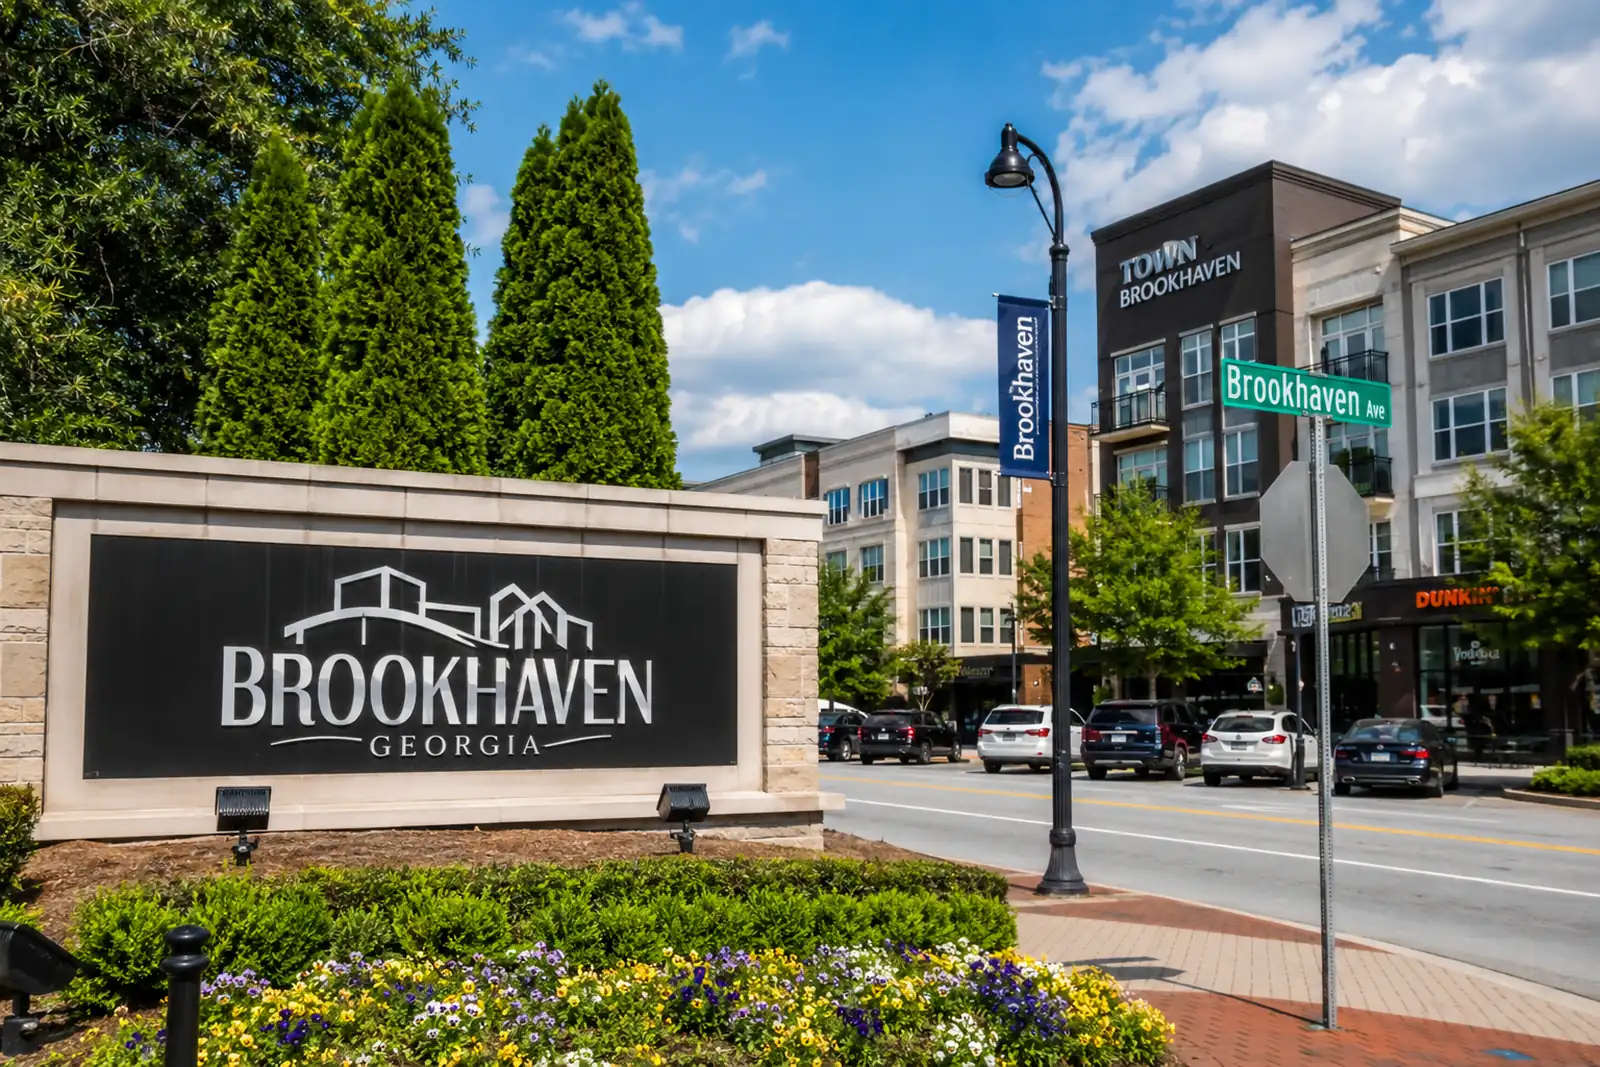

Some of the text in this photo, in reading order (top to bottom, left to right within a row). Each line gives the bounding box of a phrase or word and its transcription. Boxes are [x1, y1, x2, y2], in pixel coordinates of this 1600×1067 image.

[1119, 235, 1198, 284] TOWN
[1119, 251, 1241, 308] BROOKHAVEN
[1012, 316, 1034, 461] Brookhaven
[1227, 364, 1385, 420] Brookhaven Ave
[222, 646, 653, 727] BROOKHAVEN
[370, 735, 541, 757] GEORGIA
